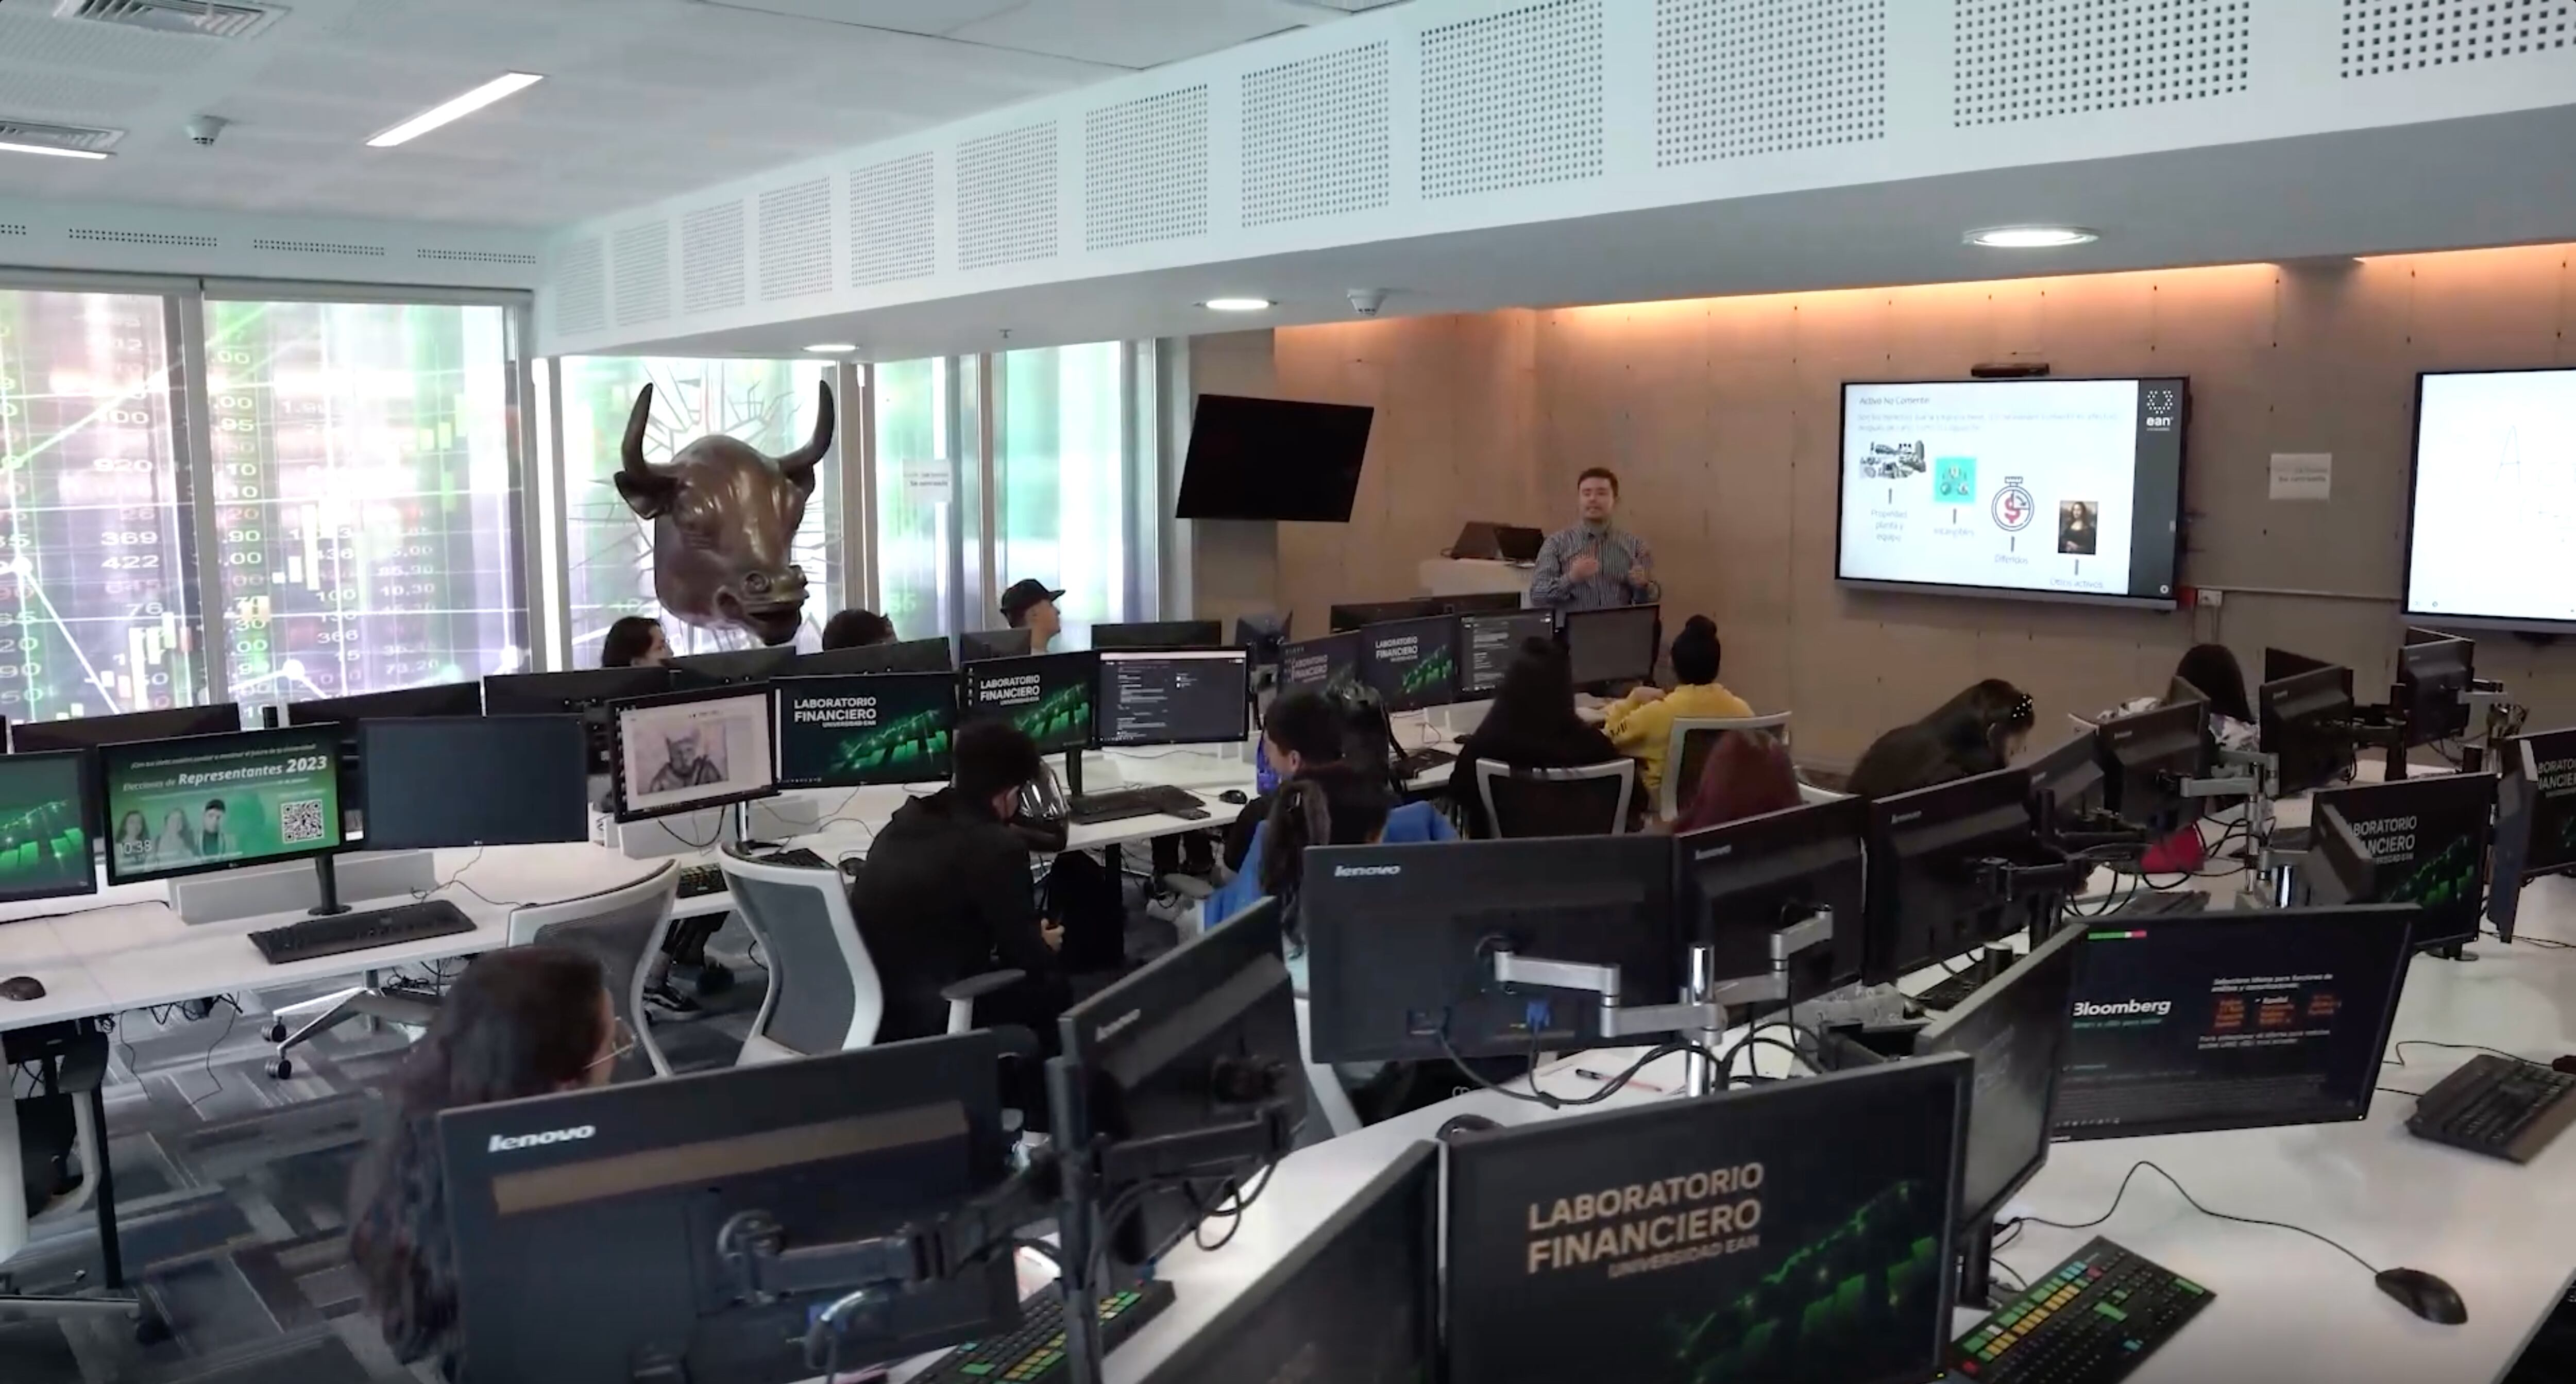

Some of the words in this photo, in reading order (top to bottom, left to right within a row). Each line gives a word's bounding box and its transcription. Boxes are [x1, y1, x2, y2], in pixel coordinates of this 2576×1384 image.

[2146, 417, 2171, 426] ean
[101, 531, 158, 546] 369
[101, 555, 159, 569] 422
[980, 674, 1040, 689] LABORATORIO
[980, 685, 1040, 701] FINANCIERO
[794, 696, 876, 710] LABORATORIO
[794, 708, 876, 722] FINANCIERO
[178, 764, 283, 786] Representantes
[285, 755, 328, 773] 2023
[1335, 865, 1401, 877] lenovo
[488, 1125, 597, 1153] lenovo
[1529, 1161, 1765, 1231] LABORATORIO
[1528, 1199, 1761, 1274] FINANCIERO
[1607, 1245, 1722, 1278] UNIVERSIDAD
[1725, 1234, 1760, 1254] EAN
